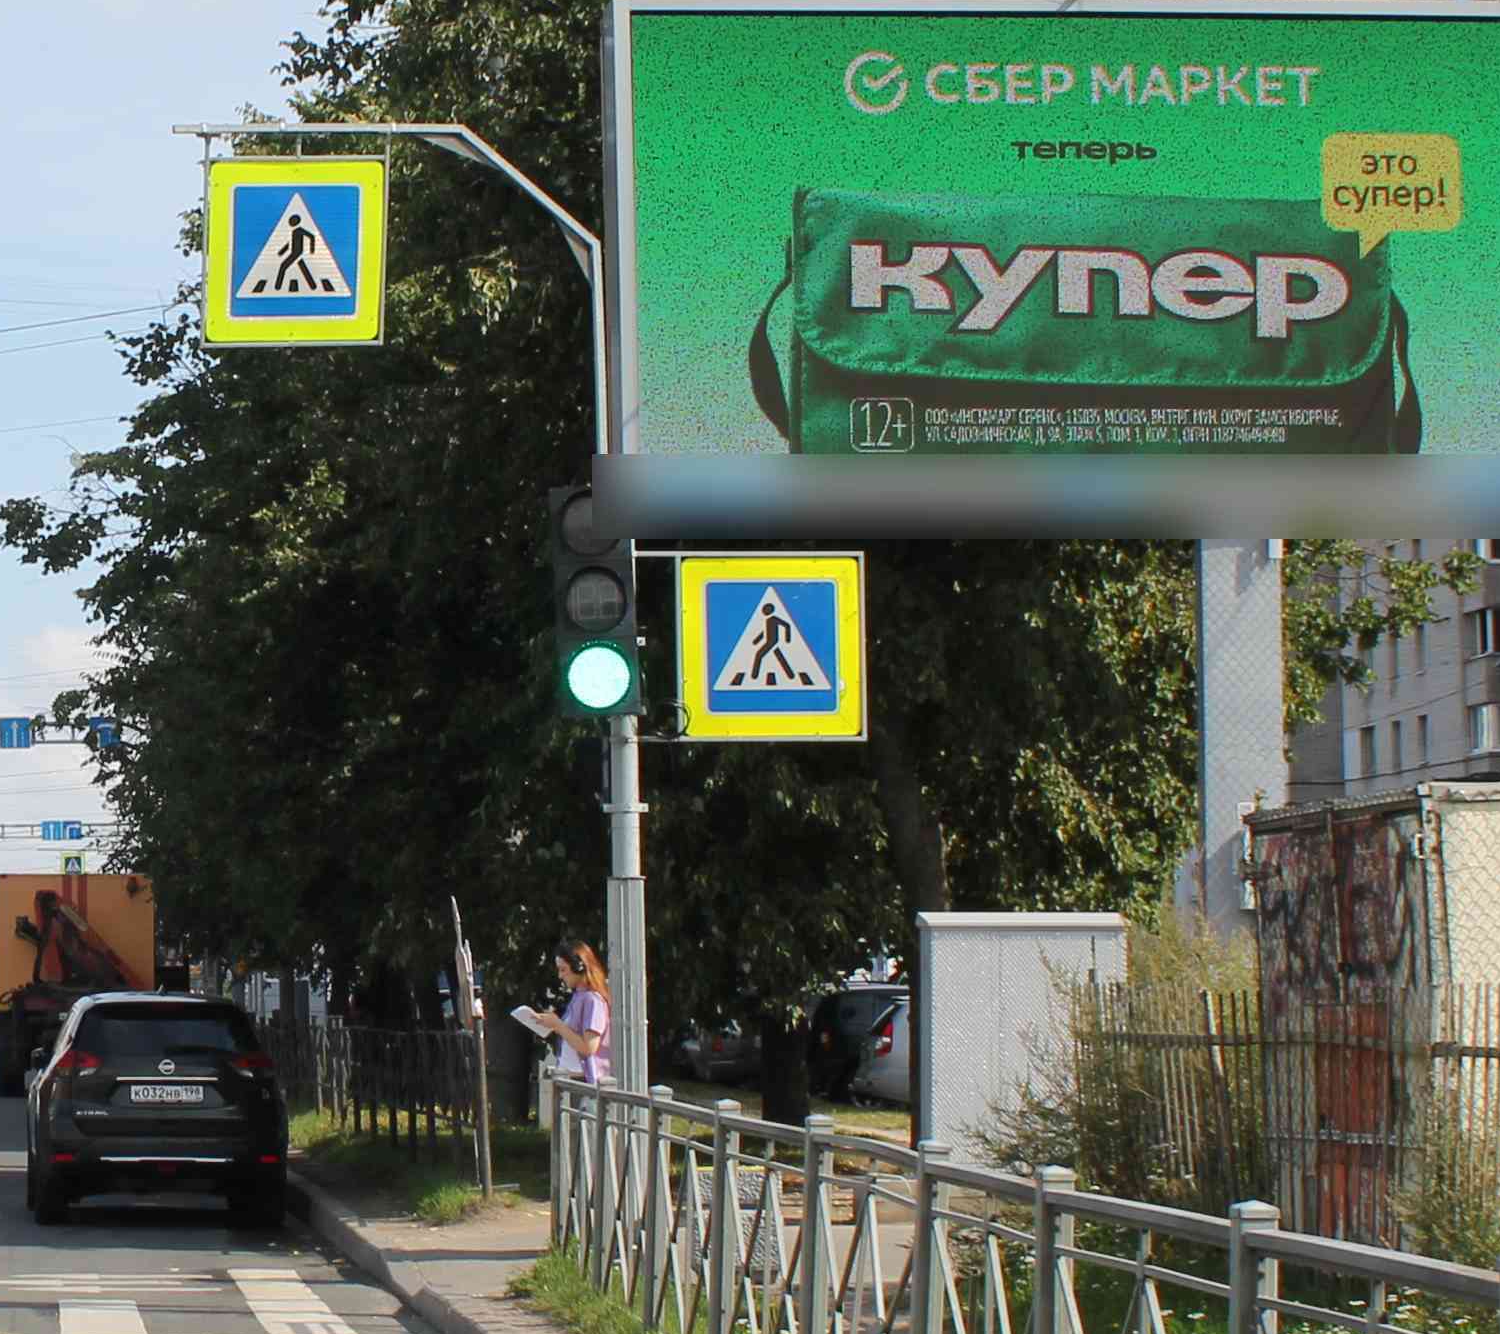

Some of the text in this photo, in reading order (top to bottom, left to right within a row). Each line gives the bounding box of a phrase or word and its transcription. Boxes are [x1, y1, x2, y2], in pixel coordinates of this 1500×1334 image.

[925, 62, 1319, 108] СБЕР МАРКЕТ
[1010, 139, 1158, 165] теперь
[1360, 152, 1419, 176] это
[1332, 176, 1447, 213] супер!
[859, 402, 908, 448] 12+
[924, 408, 948, 425] ООО
